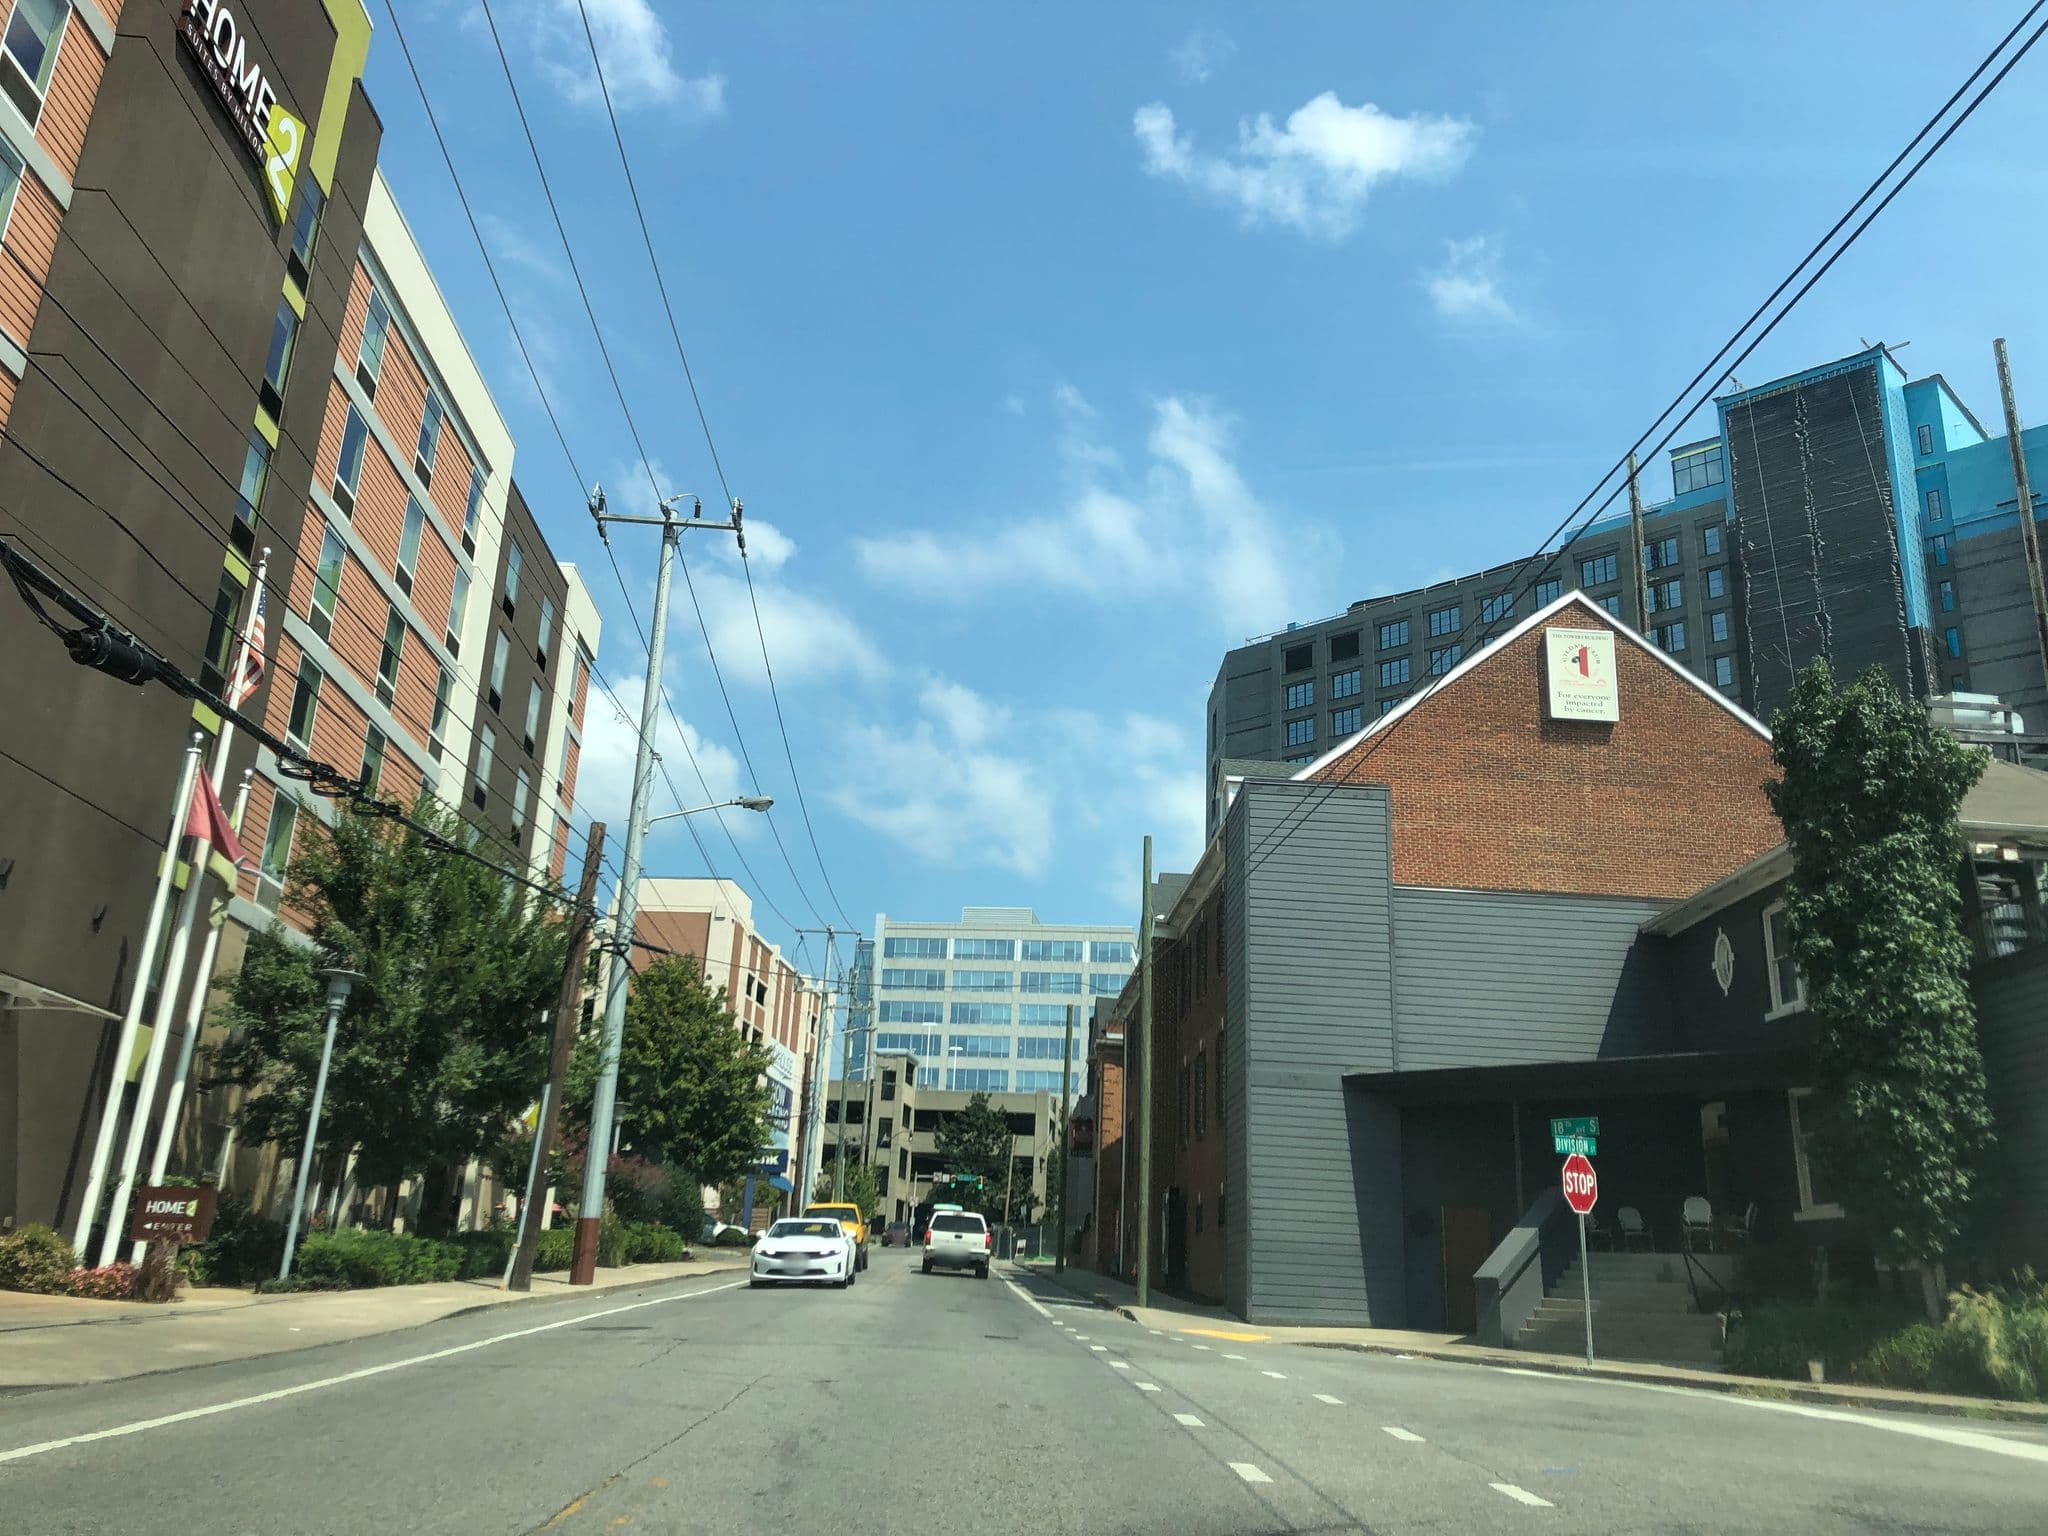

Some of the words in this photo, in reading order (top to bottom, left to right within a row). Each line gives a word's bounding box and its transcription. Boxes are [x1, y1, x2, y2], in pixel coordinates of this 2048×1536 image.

[186, 23, 220, 81] SUITES
[221, 82, 234, 103] BY
[234, 105, 263, 159] HILTON
[1573, 693, 1611, 701] everyone
[1565, 699, 1603, 707] impacted
[1564, 705, 1574, 713] by
[1589, 1119, 1596, 1133] S
[1555, 1137, 1589, 1153] DIVISION
[1565, 1172, 1594, 1195] STOP
[152, 1222, 193, 1231] ENTER
